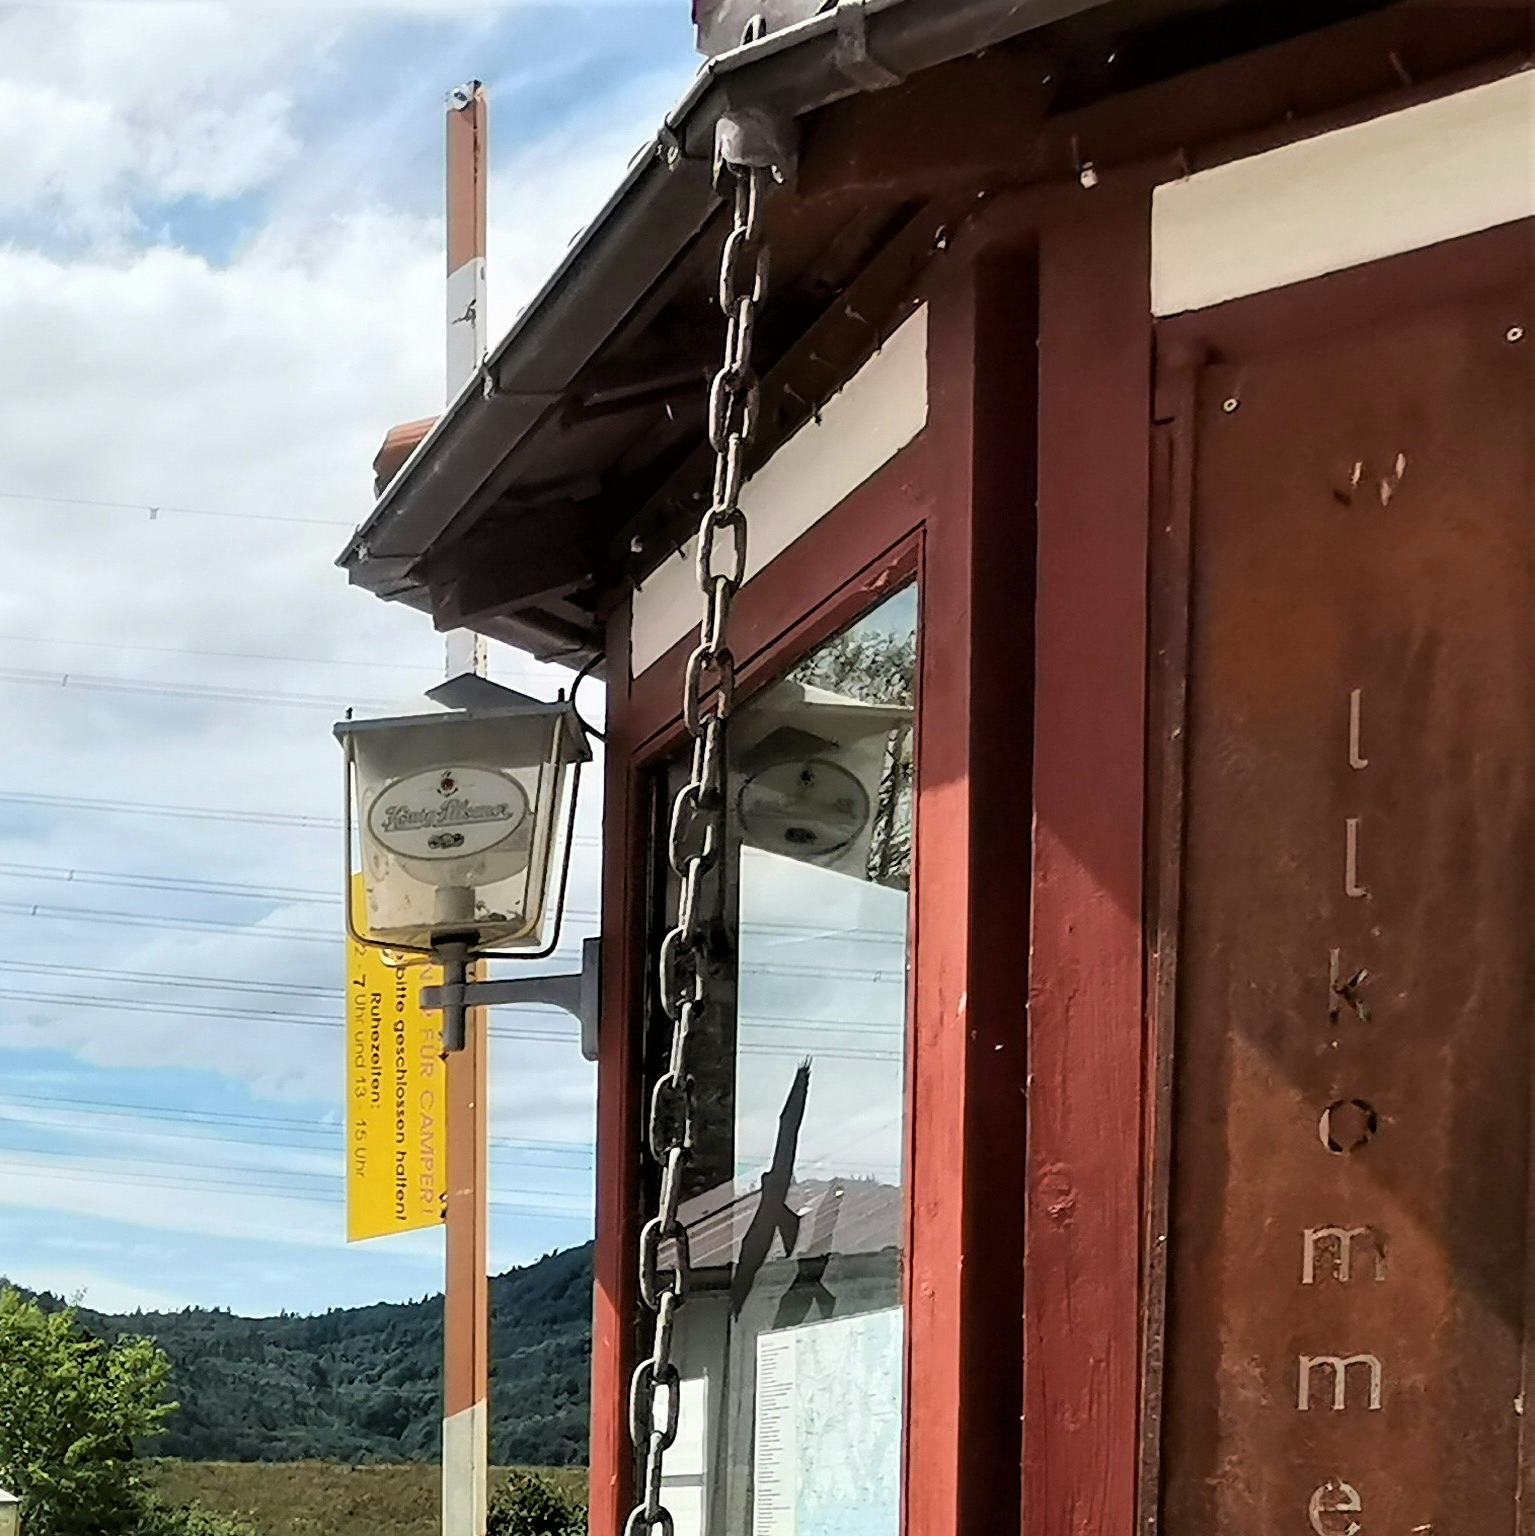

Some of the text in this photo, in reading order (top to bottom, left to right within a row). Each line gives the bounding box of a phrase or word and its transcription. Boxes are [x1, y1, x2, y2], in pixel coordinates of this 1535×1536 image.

[353, 974, 366, 987] 7
[354, 994, 367, 1022] Uhr
[354, 1030, 366, 1068] und
[370, 992, 382, 1109] Ruhezeiten:
[354, 1076, 367, 1099] 13
[393, 967, 408, 1221] bitte geschlossen halten!
[354, 1118, 367, 1142] 15
[354, 1148, 367, 1177] Uhr
[419, 1089, 435, 1215] CAMPER!
